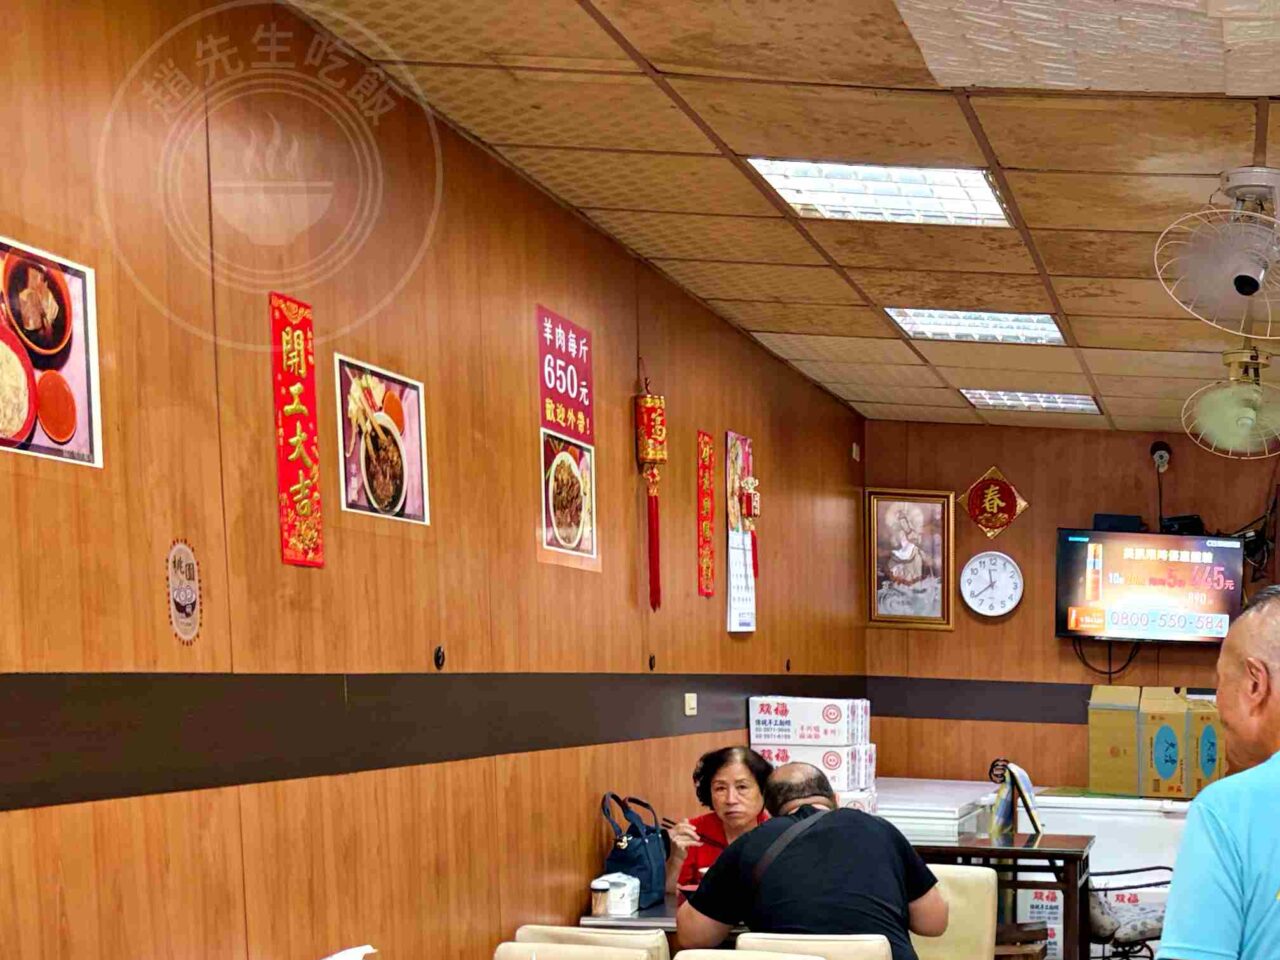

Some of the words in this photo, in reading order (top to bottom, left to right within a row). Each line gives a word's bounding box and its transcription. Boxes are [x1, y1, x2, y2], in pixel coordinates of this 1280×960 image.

[543, 317, 589, 363] 羊肉每斤
[543, 353, 589, 406] 650元
[281, 325, 313, 517] 開工大吉
[982, 484, 1006, 513] 春
